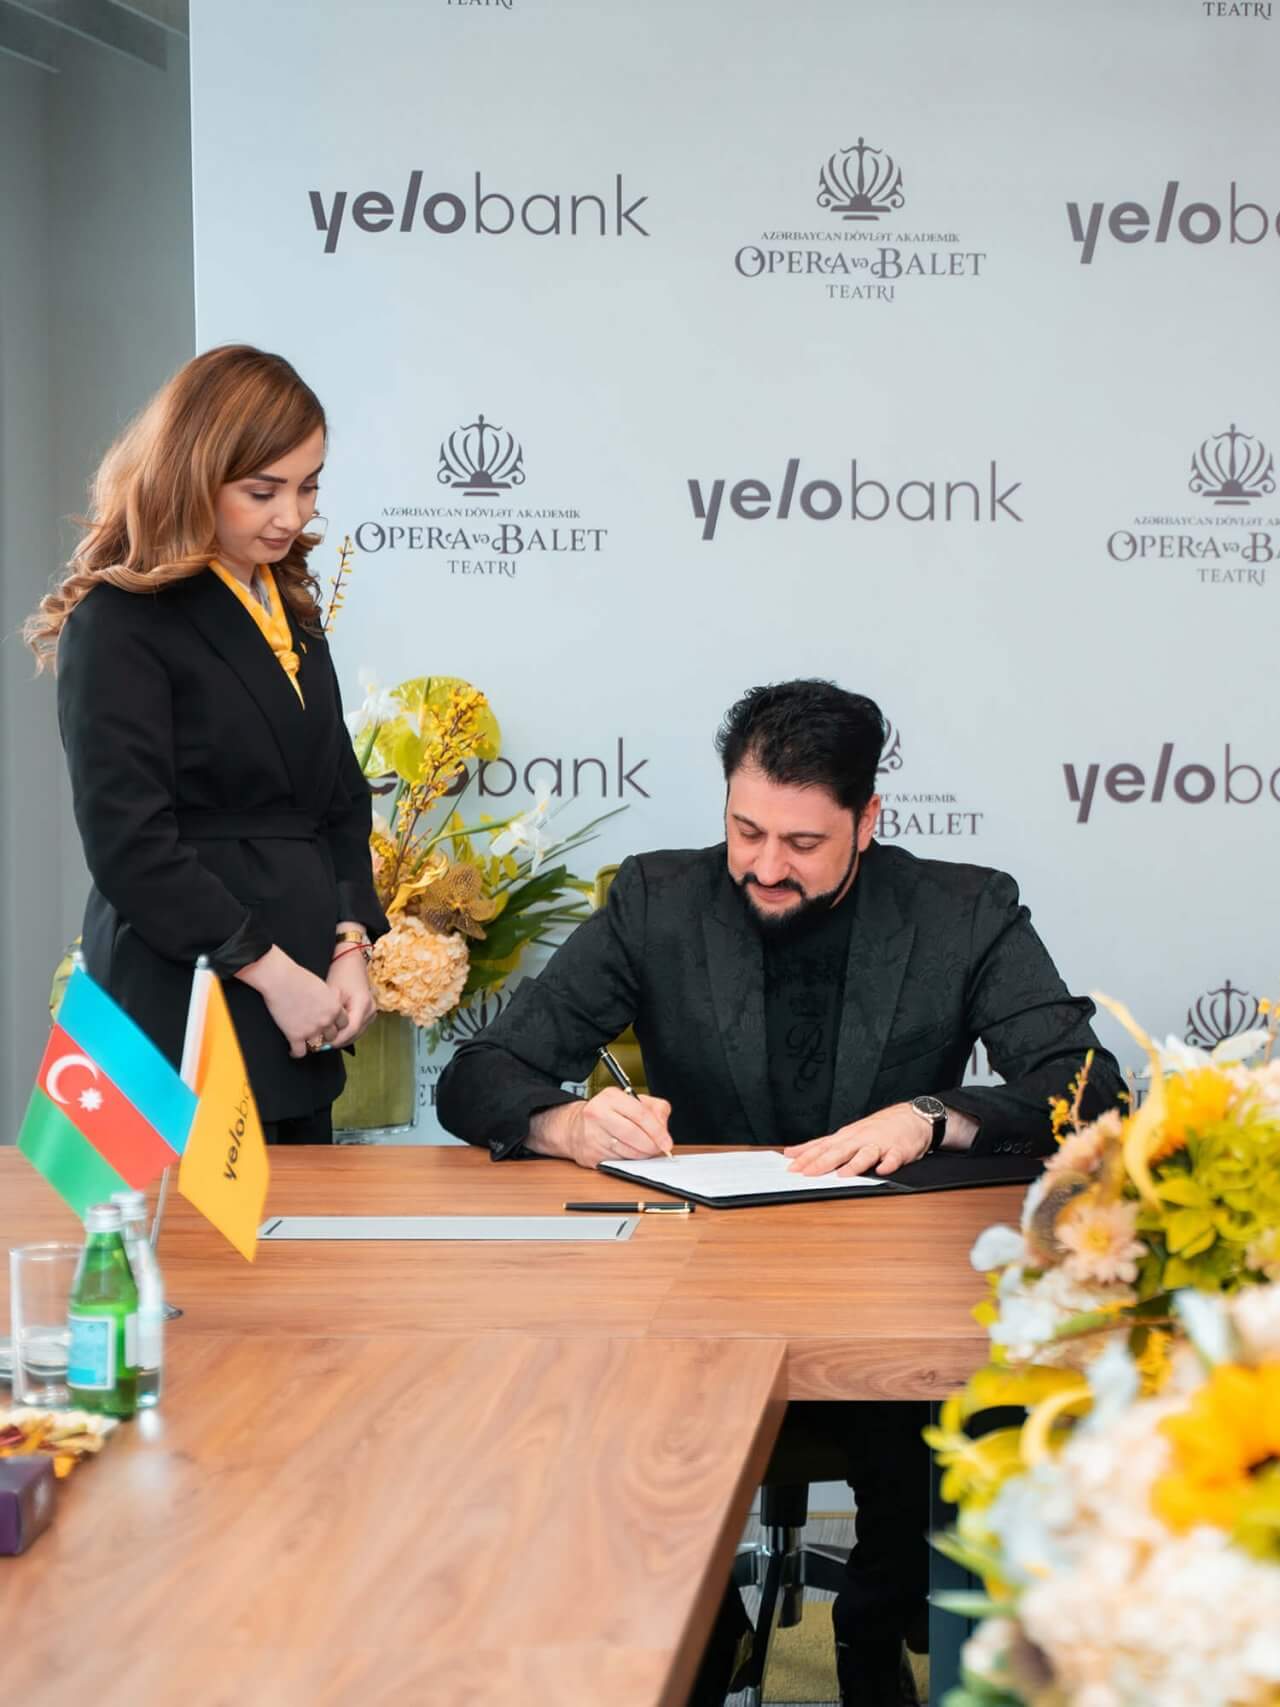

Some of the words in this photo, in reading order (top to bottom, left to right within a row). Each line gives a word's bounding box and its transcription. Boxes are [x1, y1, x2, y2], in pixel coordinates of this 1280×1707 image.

[309, 170, 649, 253] yelobank
[735, 246, 850, 277] OPERA
[870, 248, 986, 279] BALET
[688, 458, 1023, 540] yelobank
[355, 522, 471, 552] OPERA
[491, 524, 607, 554] BALET
[1107, 531, 1221, 561] OPERA
[873, 808, 984, 838] BALET
